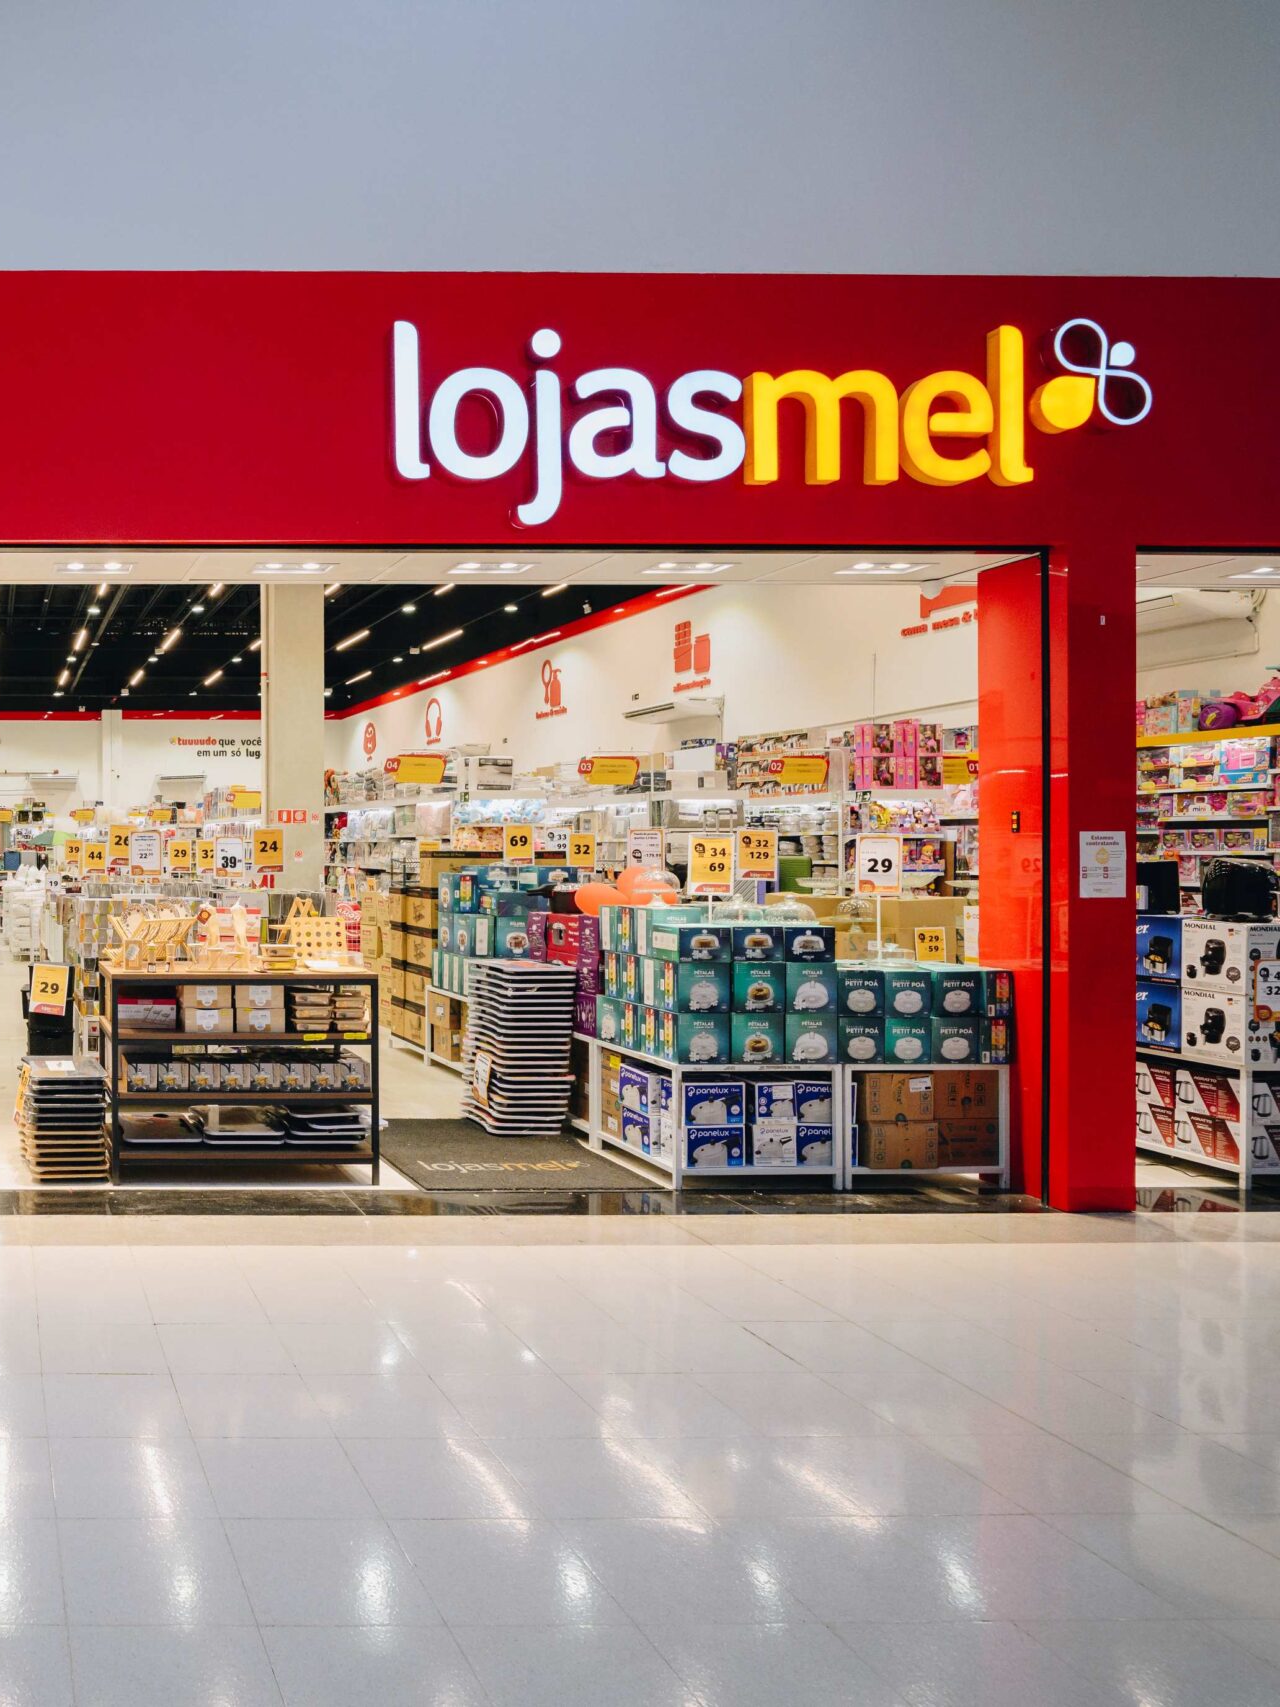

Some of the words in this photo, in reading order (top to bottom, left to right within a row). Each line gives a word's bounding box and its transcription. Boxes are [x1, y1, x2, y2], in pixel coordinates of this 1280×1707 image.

[391, 319, 1035, 527] lojasmel
[218, 738, 236, 748] que
[241, 737, 262, 746] você
[231, 748, 241, 757] só
[246, 748, 261, 759] lug
[510, 836, 528, 846] 69
[259, 841, 279, 853] 24
[574, 844, 590, 855] 32
[88, 851, 103, 860] 44
[174, 849, 187, 858] 29
[711, 848, 726, 857] 34
[221, 856, 237, 869] 39
[709, 862, 725, 872] 69
[867, 858, 892, 873] 29
[1184, 922, 1217, 930] MONDIAL
[864, 978, 878, 987] POÁ
[912, 979, 925, 988] POÁ
[961, 979, 974, 987] POÁ
[39, 982, 59, 994] 29
[1184, 990, 1215, 999] MONDIAL
[912, 1026, 925, 1034] POÁ
[696, 1085, 729, 1094] panelux
[698, 1130, 729, 1138] panelux
[417, 1160, 572, 1173] lojasmel
